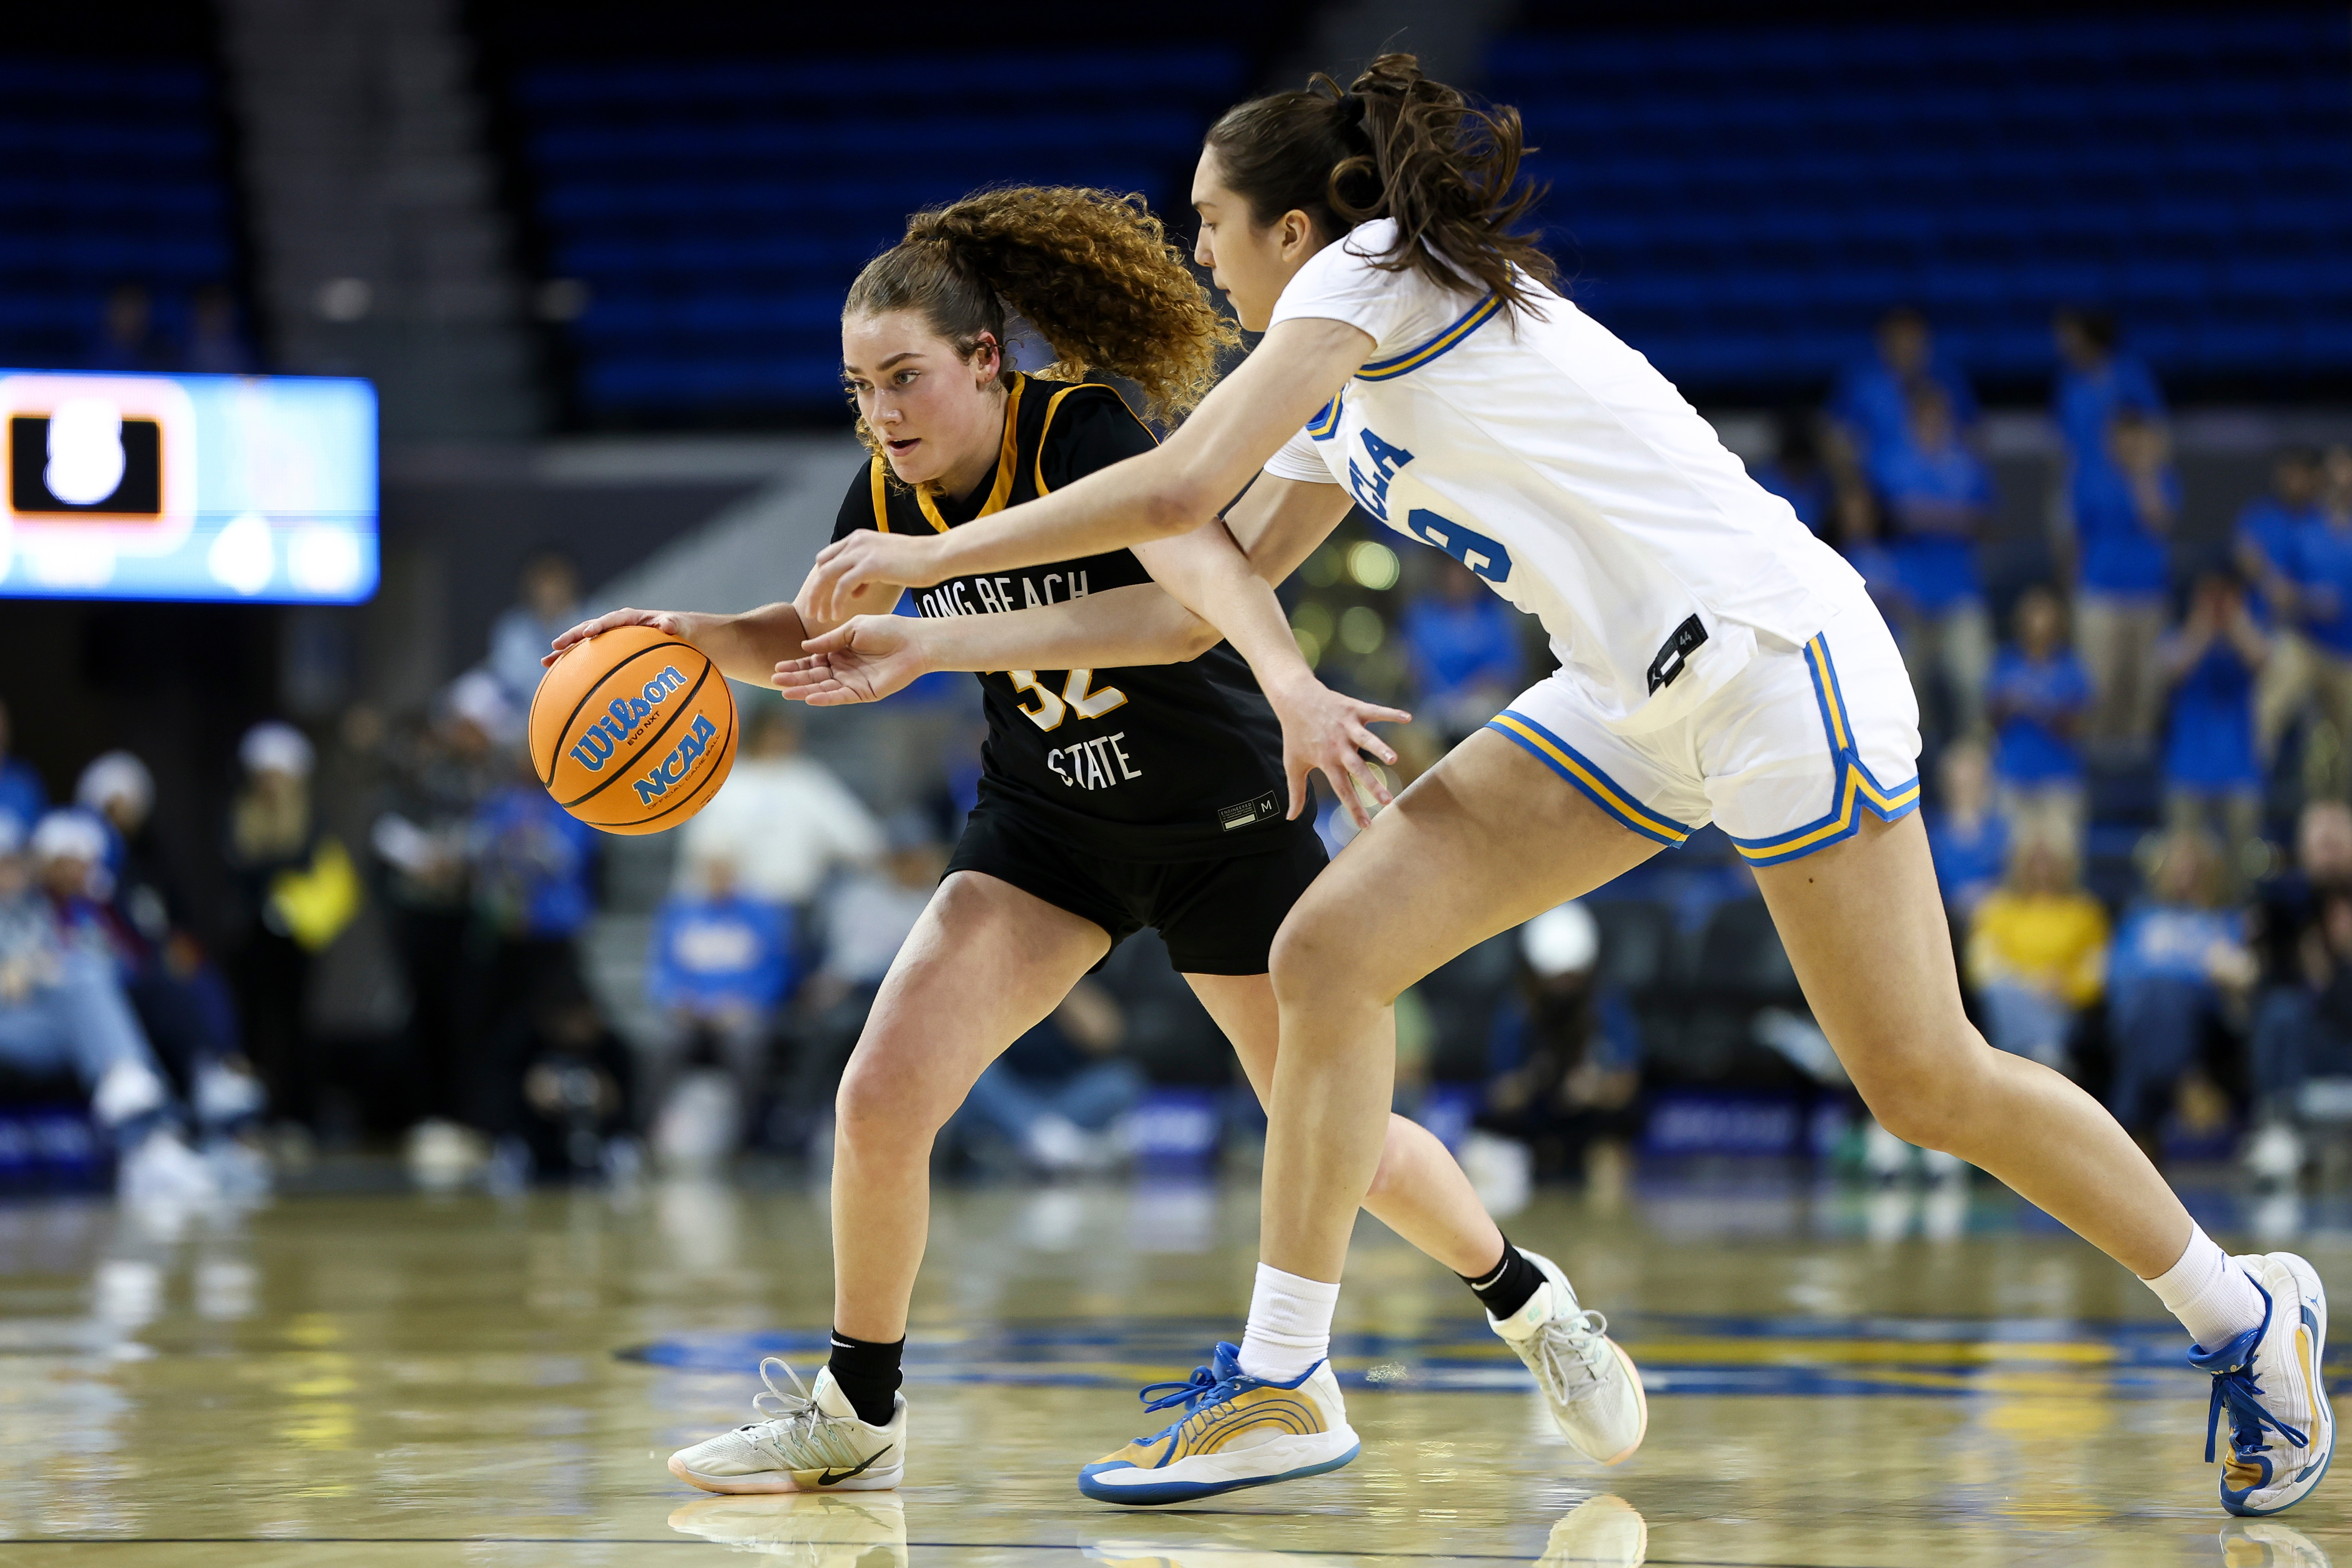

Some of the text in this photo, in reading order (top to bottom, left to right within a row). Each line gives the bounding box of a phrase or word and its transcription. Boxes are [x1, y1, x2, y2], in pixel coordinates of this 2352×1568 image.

[1349, 428, 1415, 521] CLA
[1408, 508, 1513, 583] 9
[975, 570, 1088, 614] BEACH
[568, 665, 688, 773] Wilson
[627, 710, 660, 746] EVO NXT
[632, 713, 718, 807] NCAA
[647, 782, 685, 810] OFFICIAL
[685, 757, 706, 782] GAME
[705, 734, 721, 757] BALL
[1047, 731, 1142, 790] STATE
[1221, 802, 1252, 815] ENGINEERED
[1260, 800, 1272, 813] M
